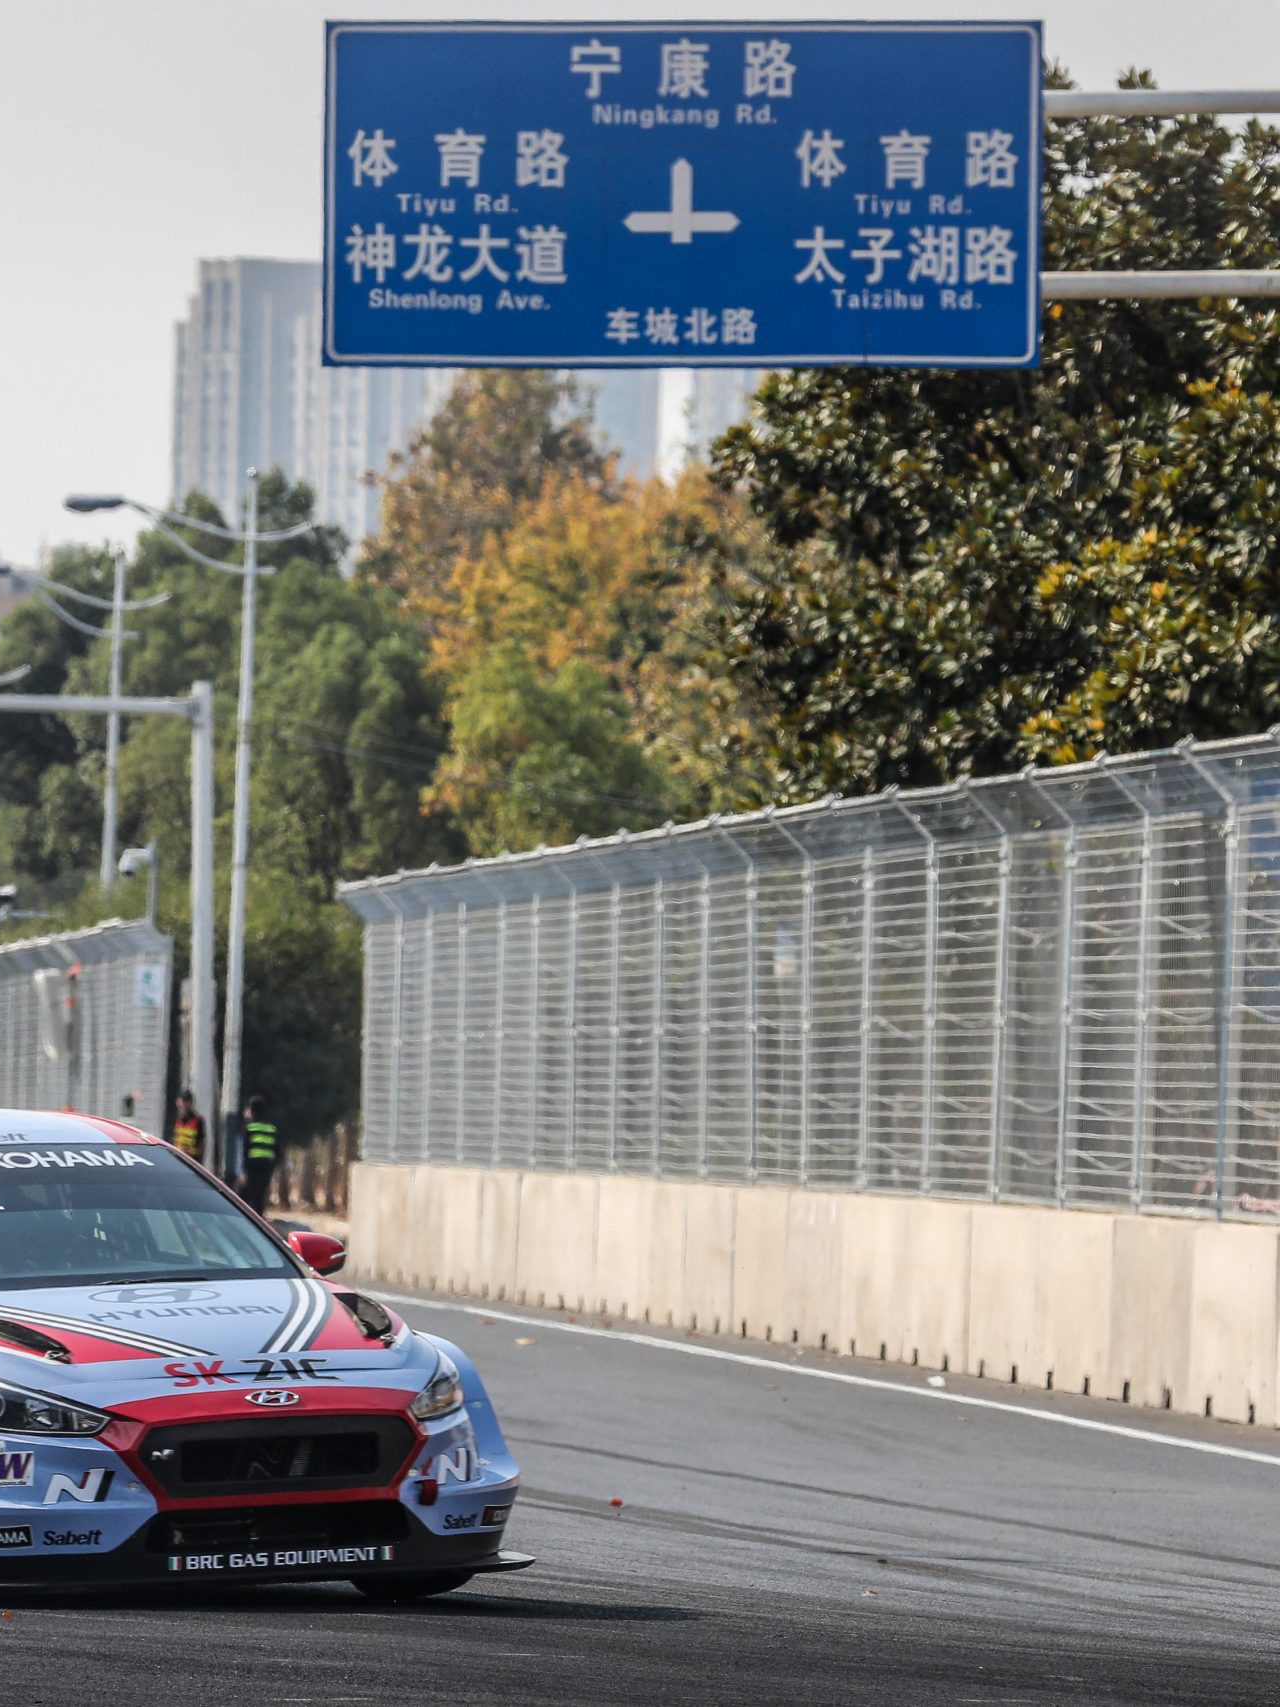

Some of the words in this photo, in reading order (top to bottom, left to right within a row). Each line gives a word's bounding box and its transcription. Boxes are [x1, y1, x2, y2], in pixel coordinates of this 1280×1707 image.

[570, 39, 797, 99] 宁康路
[592, 104, 719, 129] Ningkang
[736, 104, 778, 124] Rd.
[347, 129, 569, 188] 体育路
[795, 129, 1018, 189] 体育路
[397, 193, 455, 216] Tiyu
[474, 193, 519, 213] Rd.
[854, 194, 912, 217] Tiyu
[930, 194, 972, 214] Rd.
[346, 224, 568, 284] 神龙大道
[795, 225, 1018, 285] 太子湖路
[369, 288, 483, 313] Shenlong
[496, 289, 551, 311] Ave.
[831, 289, 924, 309] Taizihu
[941, 289, 982, 310] Rd.
[605, 308, 758, 344] 车城北路
[87, 1305, 285, 1322] HYUNDAI
[163, 1360, 239, 1388] SK
[240, 1358, 344, 1383] ZIC
[42, 1529, 102, 1546] Sabelt
[185, 1555, 224, 1570] BRC
[229, 1552, 269, 1568] GAS
[274, 1547, 378, 1566] EQUIPMENT
